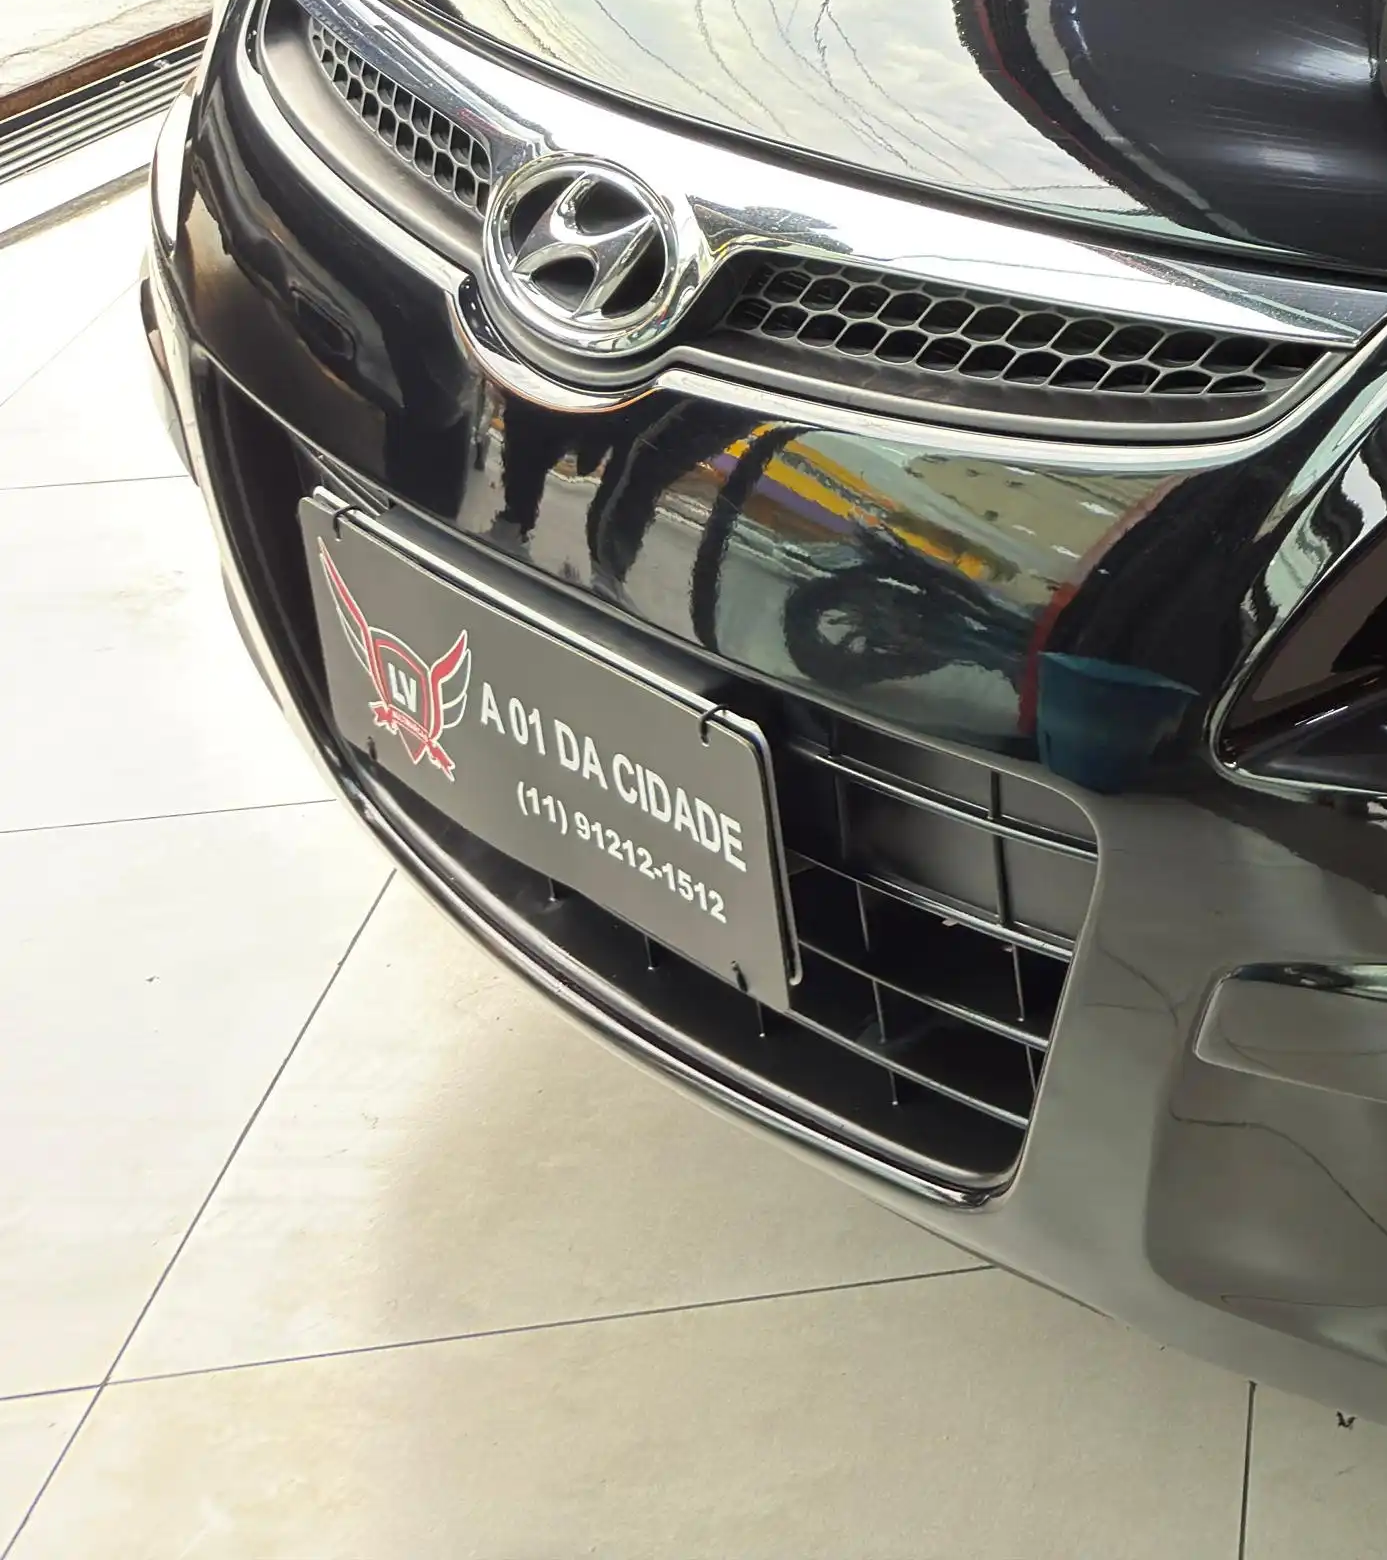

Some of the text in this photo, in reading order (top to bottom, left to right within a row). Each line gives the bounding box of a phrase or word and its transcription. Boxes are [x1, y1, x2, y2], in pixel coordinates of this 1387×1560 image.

[387, 662, 417, 712] LV
[480, 682, 505, 735] A
[508, 697, 546, 755] 01
[554, 719, 608, 790] DA
[612, 753, 747, 872] CIDADE
[517, 782, 727, 924] (11) 91212-1512
